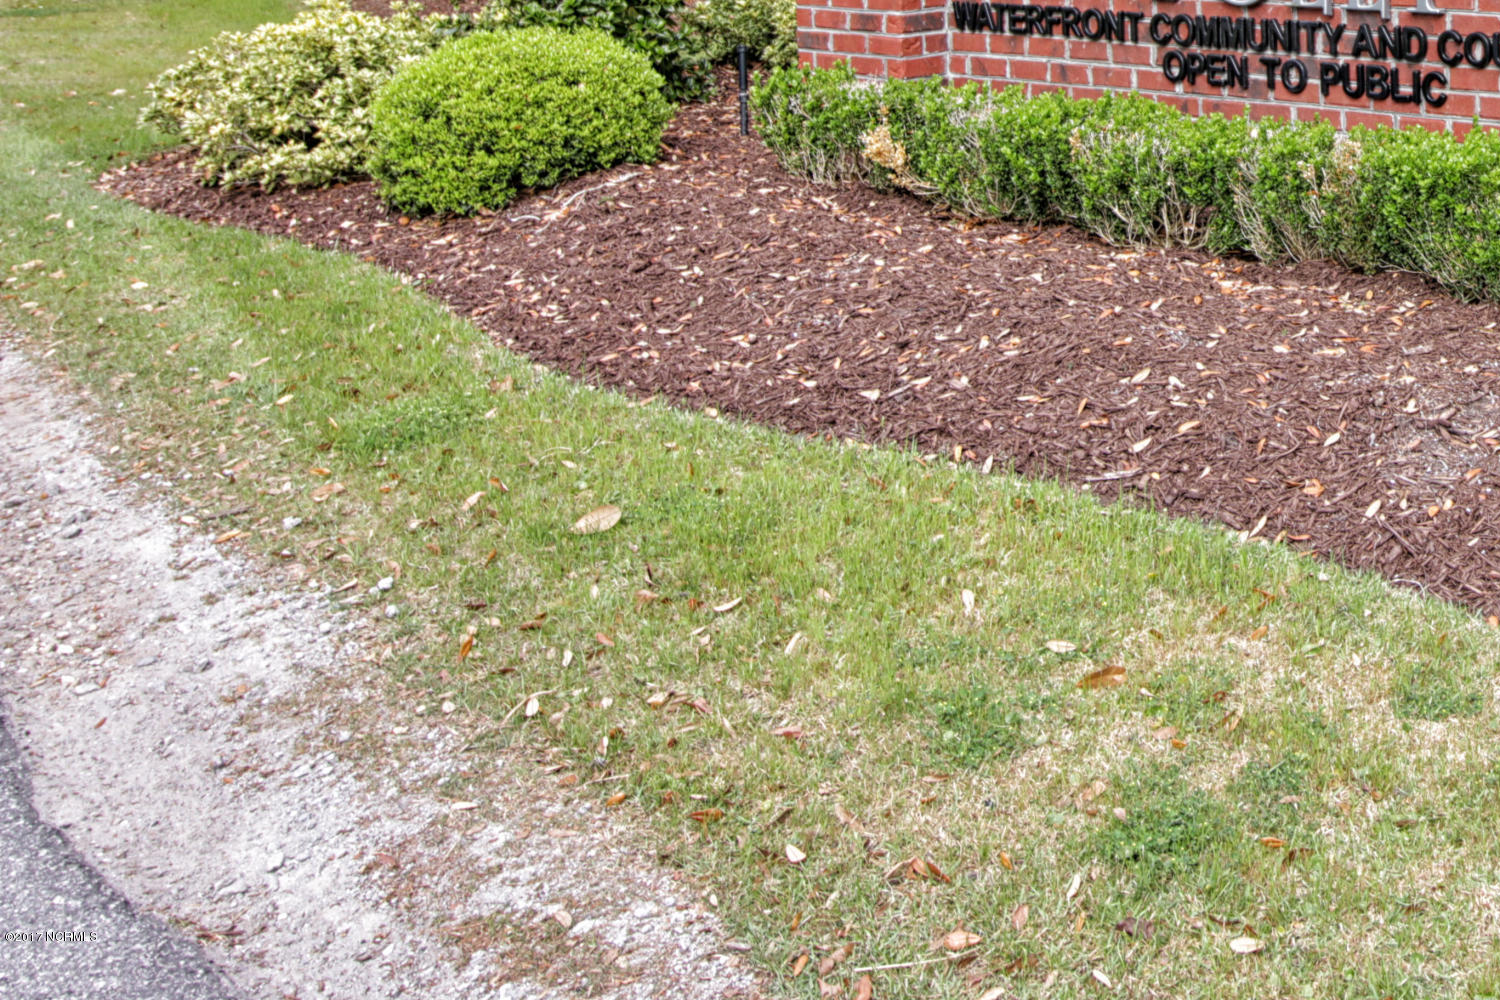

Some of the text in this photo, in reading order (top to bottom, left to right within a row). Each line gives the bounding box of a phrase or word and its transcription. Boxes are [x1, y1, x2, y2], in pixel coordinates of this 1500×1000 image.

[952, 0, 1143, 43] WATERFRONT
[1150, 12, 1346, 57] COMMUNITY
[1352, 23, 1428, 63] AND
[1163, 49, 1448, 107] OPEN TO PUBLIC
